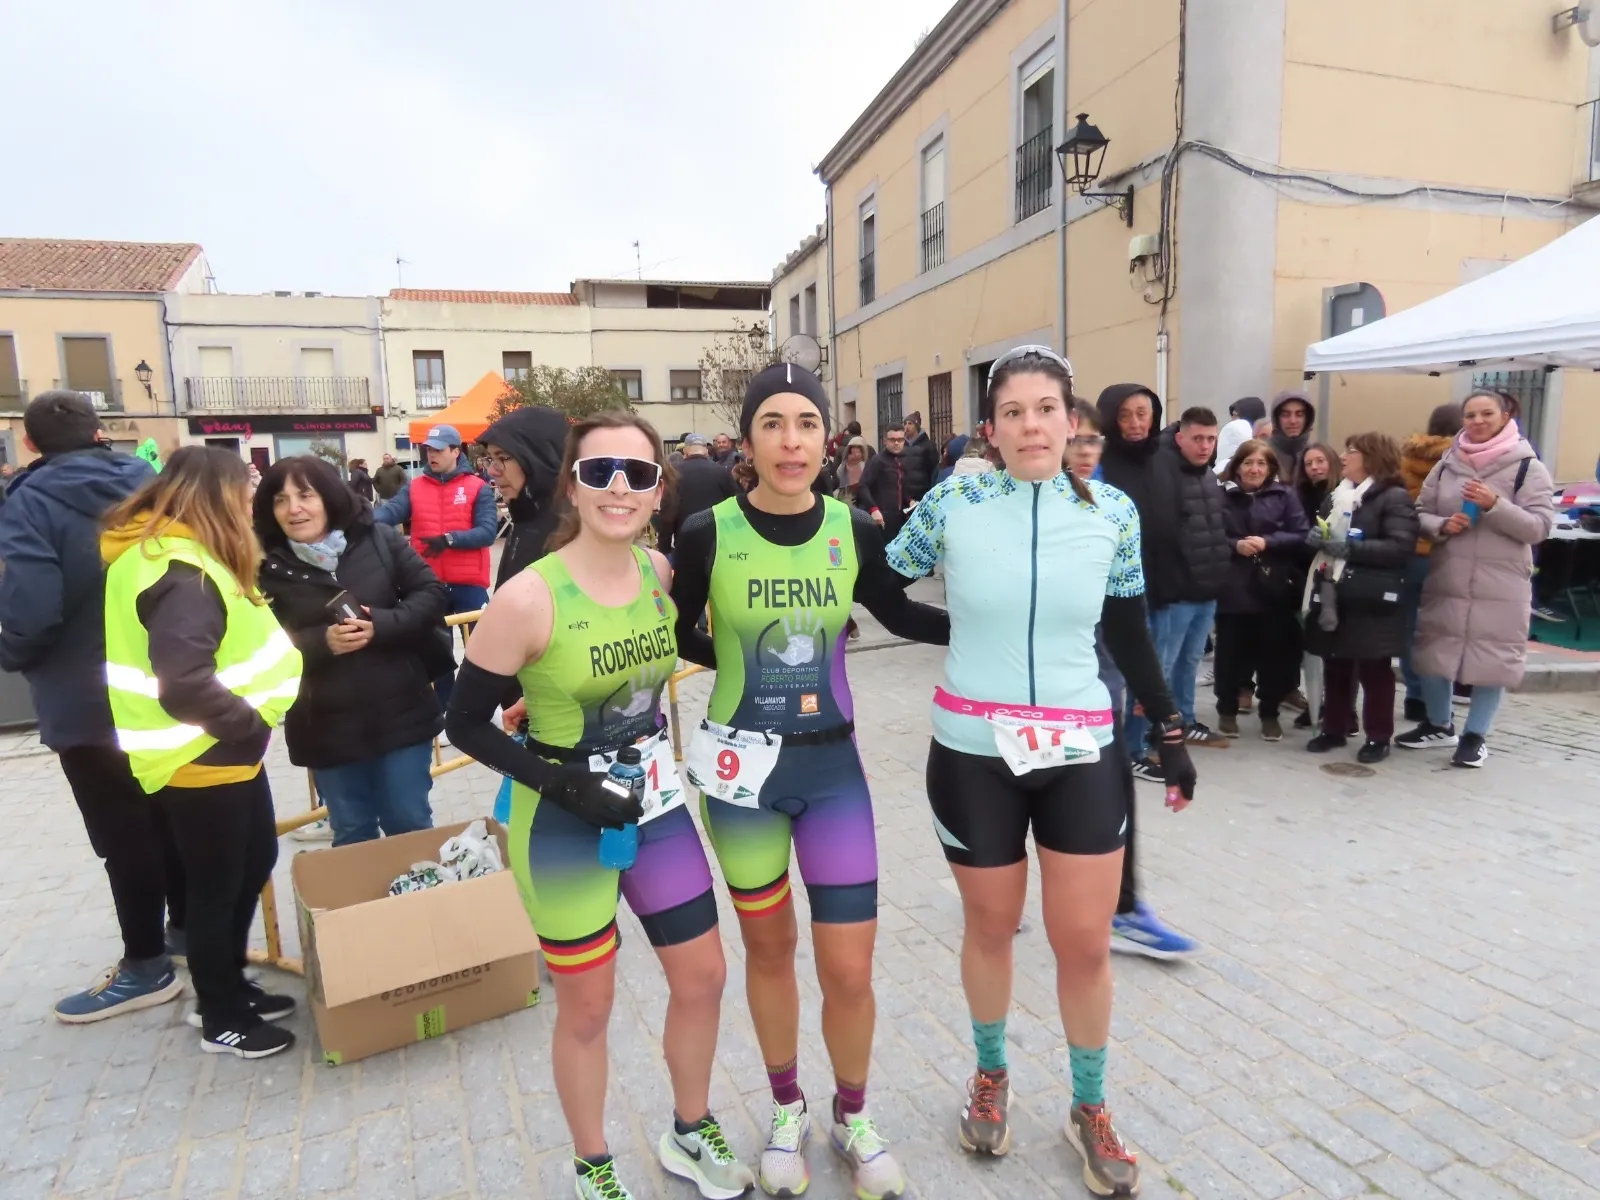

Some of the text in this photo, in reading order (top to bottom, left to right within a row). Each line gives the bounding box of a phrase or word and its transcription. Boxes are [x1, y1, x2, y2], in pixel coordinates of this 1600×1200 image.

[334, 421, 372, 430] DENTAL
[748, 577, 838, 609] PIERNA
[589, 624, 675, 678] RODRÍGUEZ
[782, 666, 820, 674] DEPORTIVO
[761, 673, 819, 683] ROBERTO RAMOS
[754, 696, 786, 705] VILLAMAYOR
[995, 708, 1044, 719] orca
[1016, 725, 1066, 752] 17
[715, 749, 740, 781] 9
